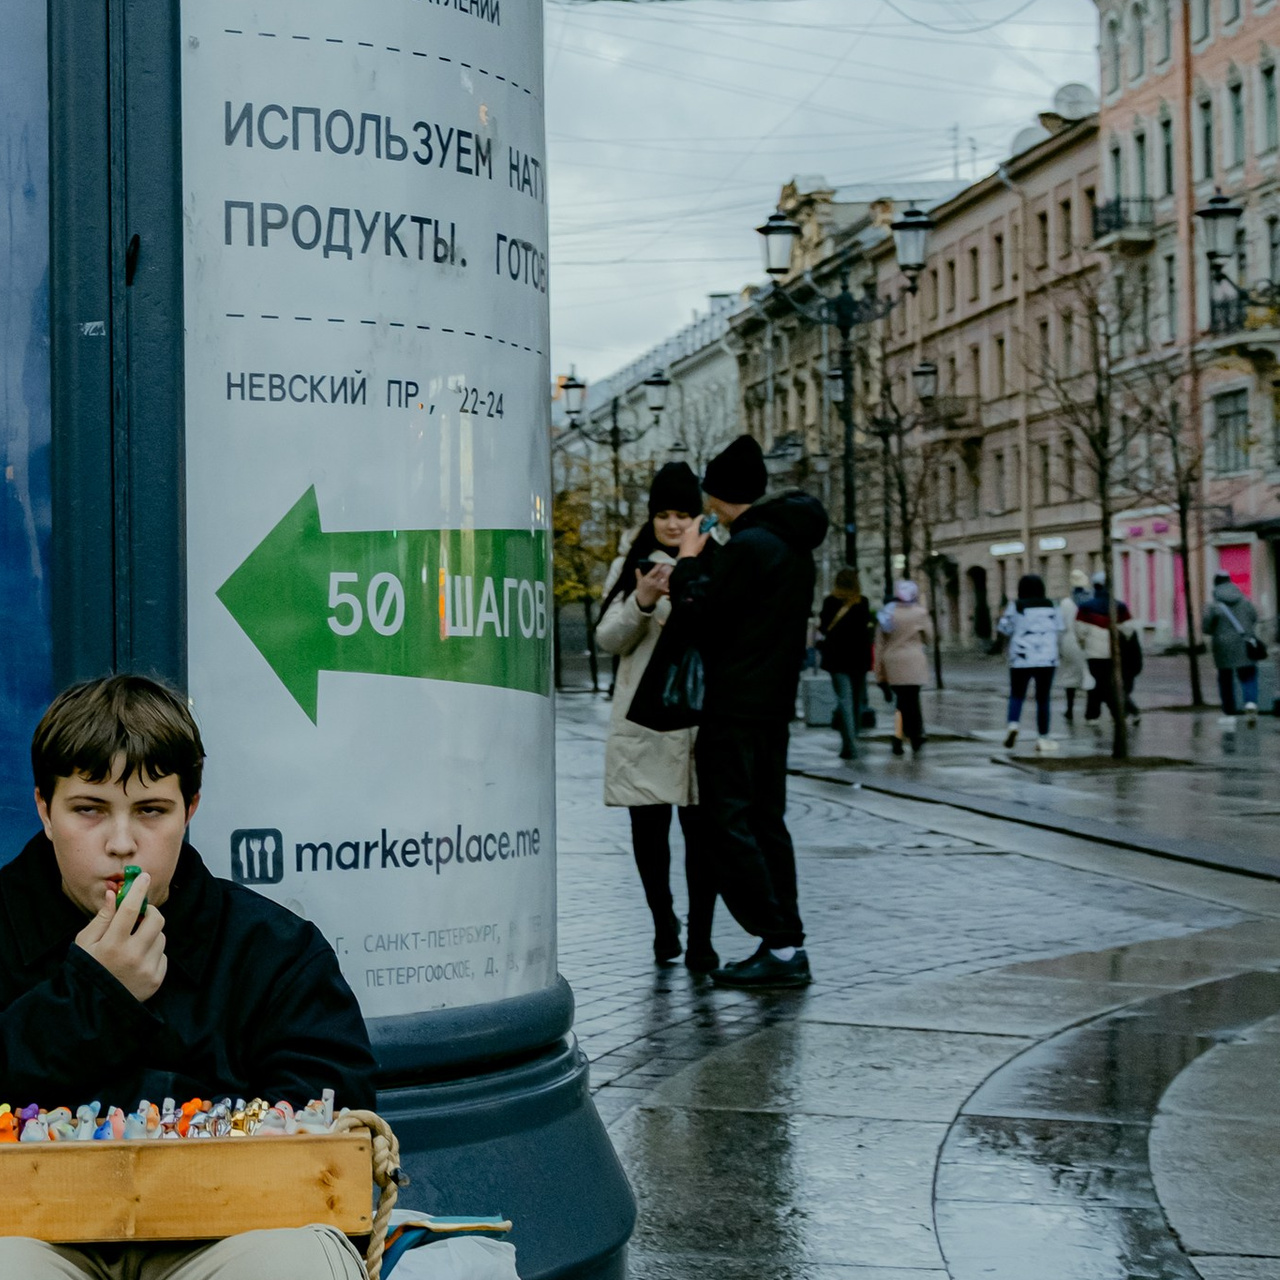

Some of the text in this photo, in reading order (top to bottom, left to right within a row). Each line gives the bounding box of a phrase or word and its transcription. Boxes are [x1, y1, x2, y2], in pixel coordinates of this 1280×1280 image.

[223, 100, 493, 180] ИСПОЛЬЗУЕМ
[224, 200, 468, 268] ПРОДУКТЫ.
[226, 370, 367, 406] НЕВСКИЙ
[459, 386, 504, 420] 22-24
[327, 571, 548, 640] 50 ШАГОВ
[294, 823, 541, 875] marketplace.me
[363, 923, 501, 953] САНКТ-ПЕТЕРБУРГ,
